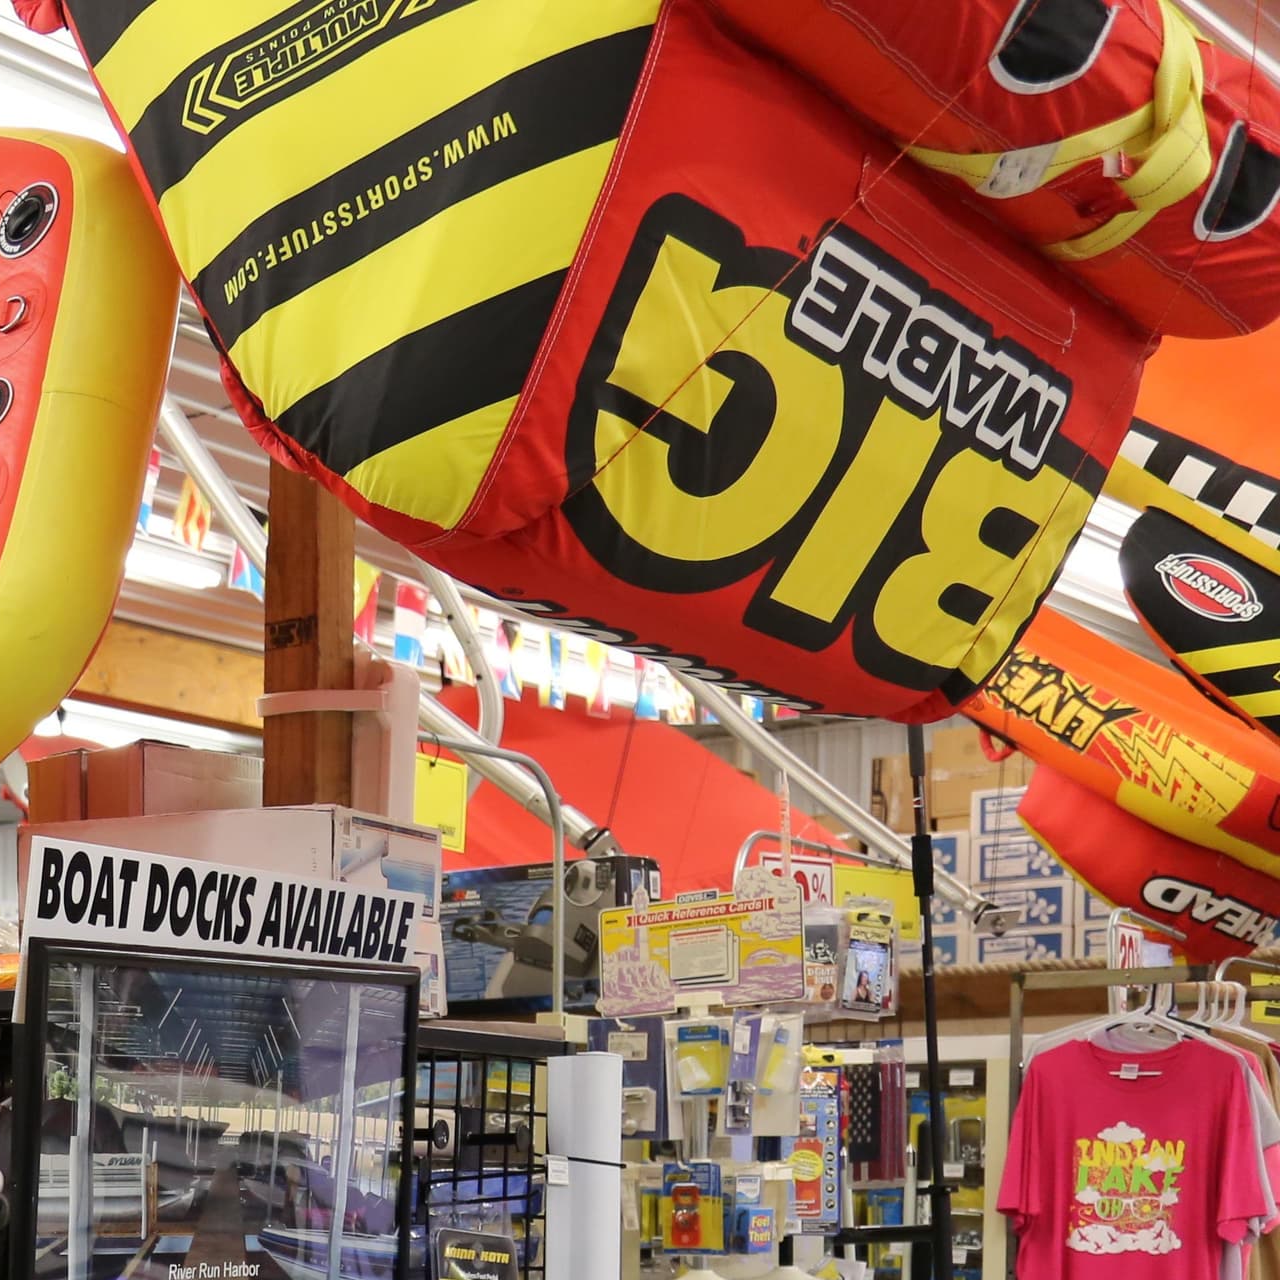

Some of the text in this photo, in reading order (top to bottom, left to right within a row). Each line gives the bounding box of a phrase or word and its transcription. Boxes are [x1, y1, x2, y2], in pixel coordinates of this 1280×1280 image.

[233, 0, 379, 97] MULTIPLE
[245, 22, 311, 63] POINTS
[224, 111, 518, 305] WWW.SPORTSSTUFF.COM
[790, 236, 1068, 472] MABLE
[590, 233, 1097, 685] BIG
[1158, 556, 1261, 619] SPORTSSTUFF
[1000, 664, 1106, 751] LIVE
[37, 847, 415, 965] BOAT DOCKS AVAILABLE
[639, 900, 762, 925] Quick Reference Cards
[1076, 1138, 1186, 1168] INDIAN
[1077, 1166, 1185, 1194] LAKE
[168, 1262, 260, 1280] River Run Harbor
